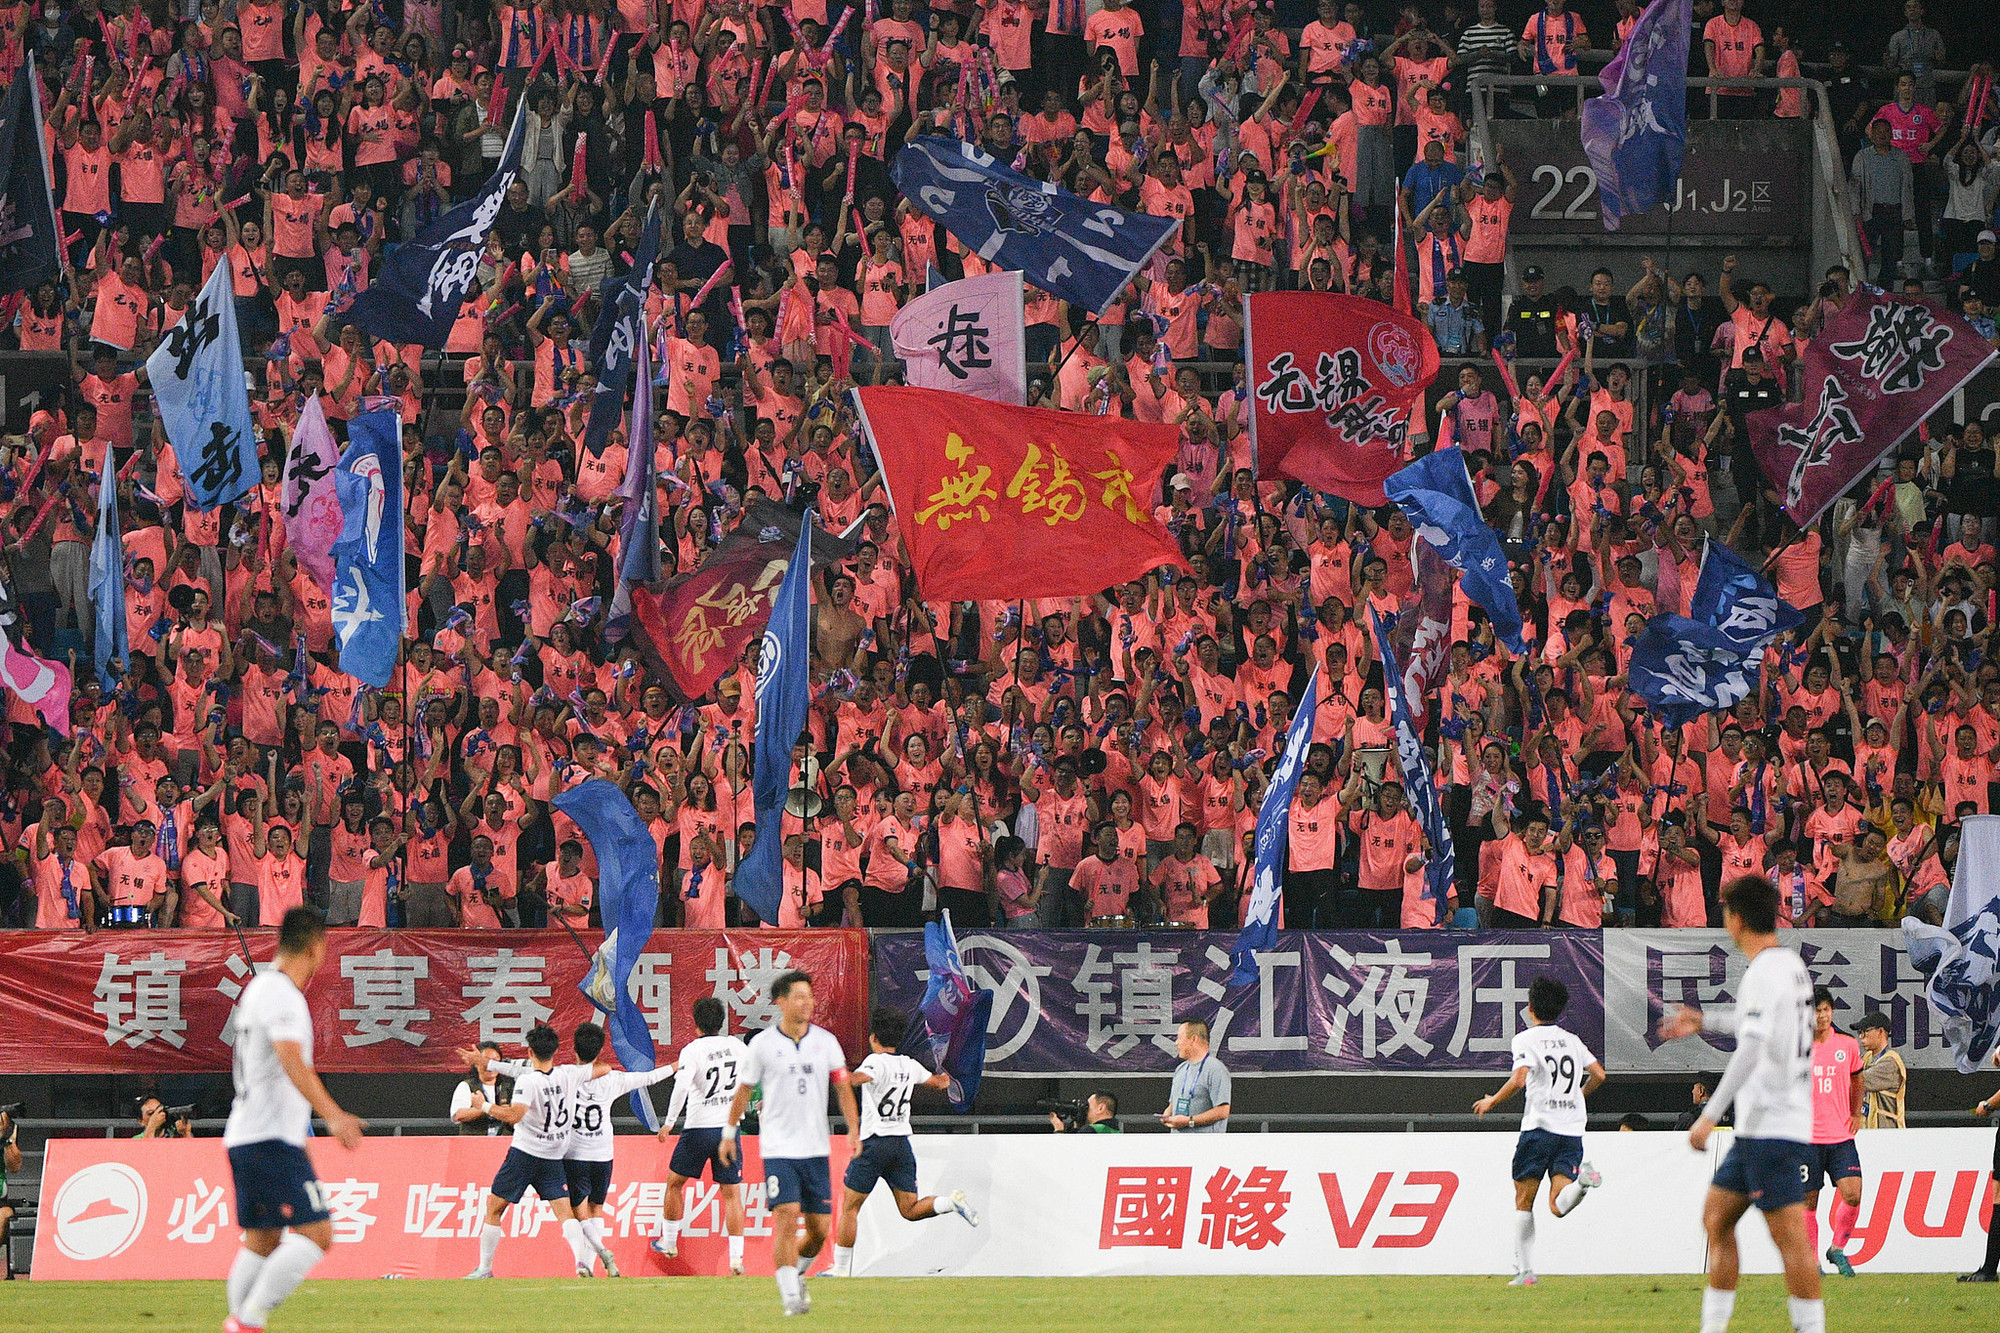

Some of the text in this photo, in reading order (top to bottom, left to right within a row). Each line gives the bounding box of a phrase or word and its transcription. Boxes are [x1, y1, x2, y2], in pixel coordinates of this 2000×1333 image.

[1103, 27, 1131, 39] 无锡
[1723, 41, 1744, 51] 无锡
[1530, 165, 1597, 220] 22
[684, 362, 707, 375] 无锡
[1257, 347, 1372, 415] 无锡
[1463, 419, 1488, 433] 无锡
[1208, 797, 1231, 807] 无锡
[1298, 822, 1318, 832] 无锡
[1372, 836, 1394, 848] 无锡
[121, 875, 144, 888] 无锡
[94, 947, 796, 1049] 镇宴春酒楼
[1072, 938, 1551, 1059] 镇江液压
[705, 1061, 737, 1099] 23
[1544, 1054, 1575, 1094] 99
[1818, 1078, 1832, 1094] 18
[797, 1078, 807, 1095] 8
[544, 1096, 568, 1132] 16
[766, 1174, 780, 1198] 8
[166, 1178, 378, 1244] 必客
[1098, 1166, 1460, 1250] 國緣 V3
[1829, 1171, 1993, 1266] yu
